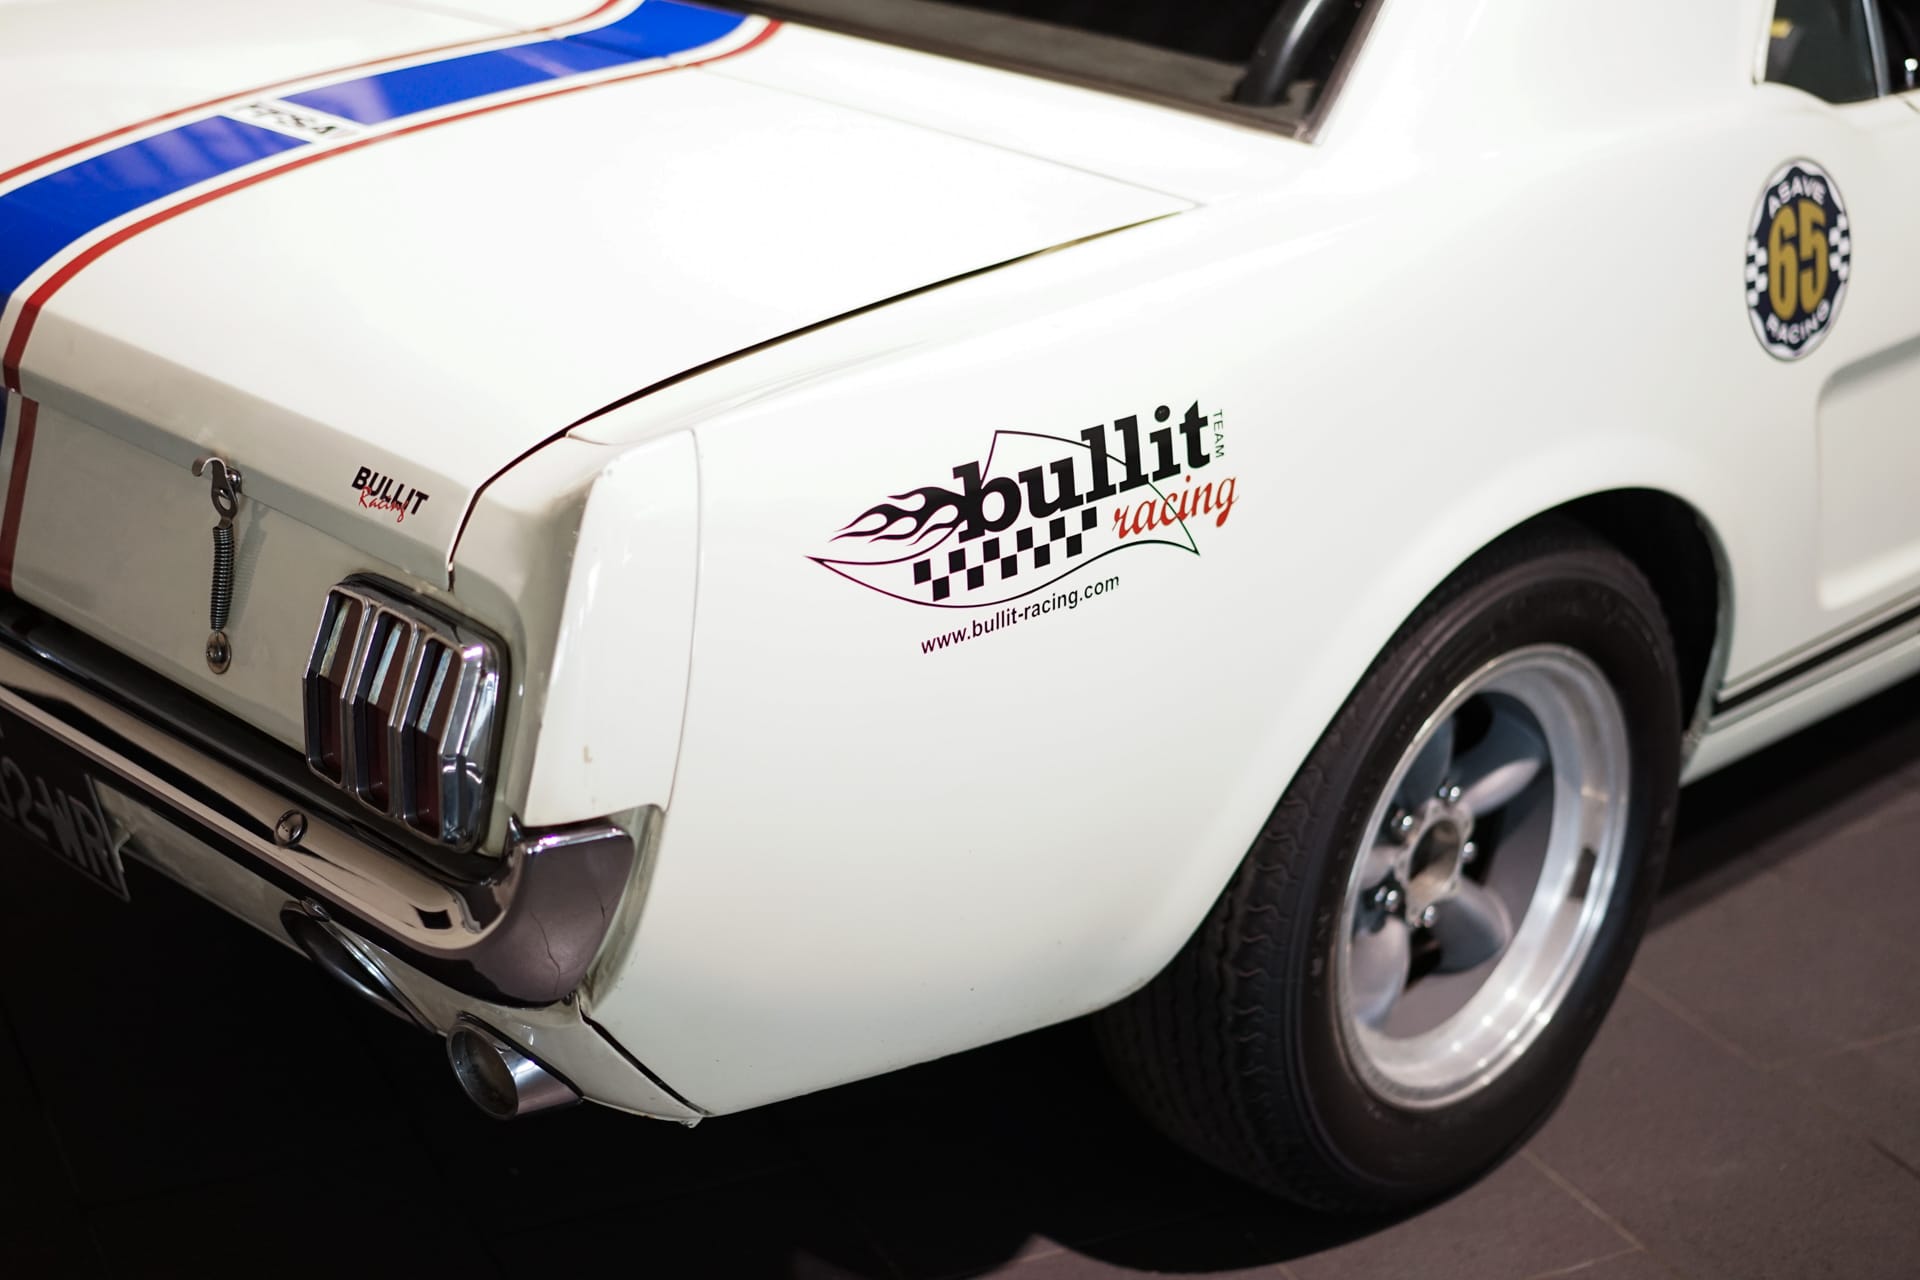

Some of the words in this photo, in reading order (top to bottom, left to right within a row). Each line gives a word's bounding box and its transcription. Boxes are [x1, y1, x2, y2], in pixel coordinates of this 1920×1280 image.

[1768, 198, 1829, 321] 65
[1766, 299, 1830, 344] RACING
[1213, 408, 1225, 459] TEAM
[351, 465, 429, 515] BULLIT
[953, 400, 1210, 543] bullit
[358, 485, 407, 523] Racing
[1112, 474, 1239, 539] racing
[921, 575, 1120, 655] www.bullit-racing.com
